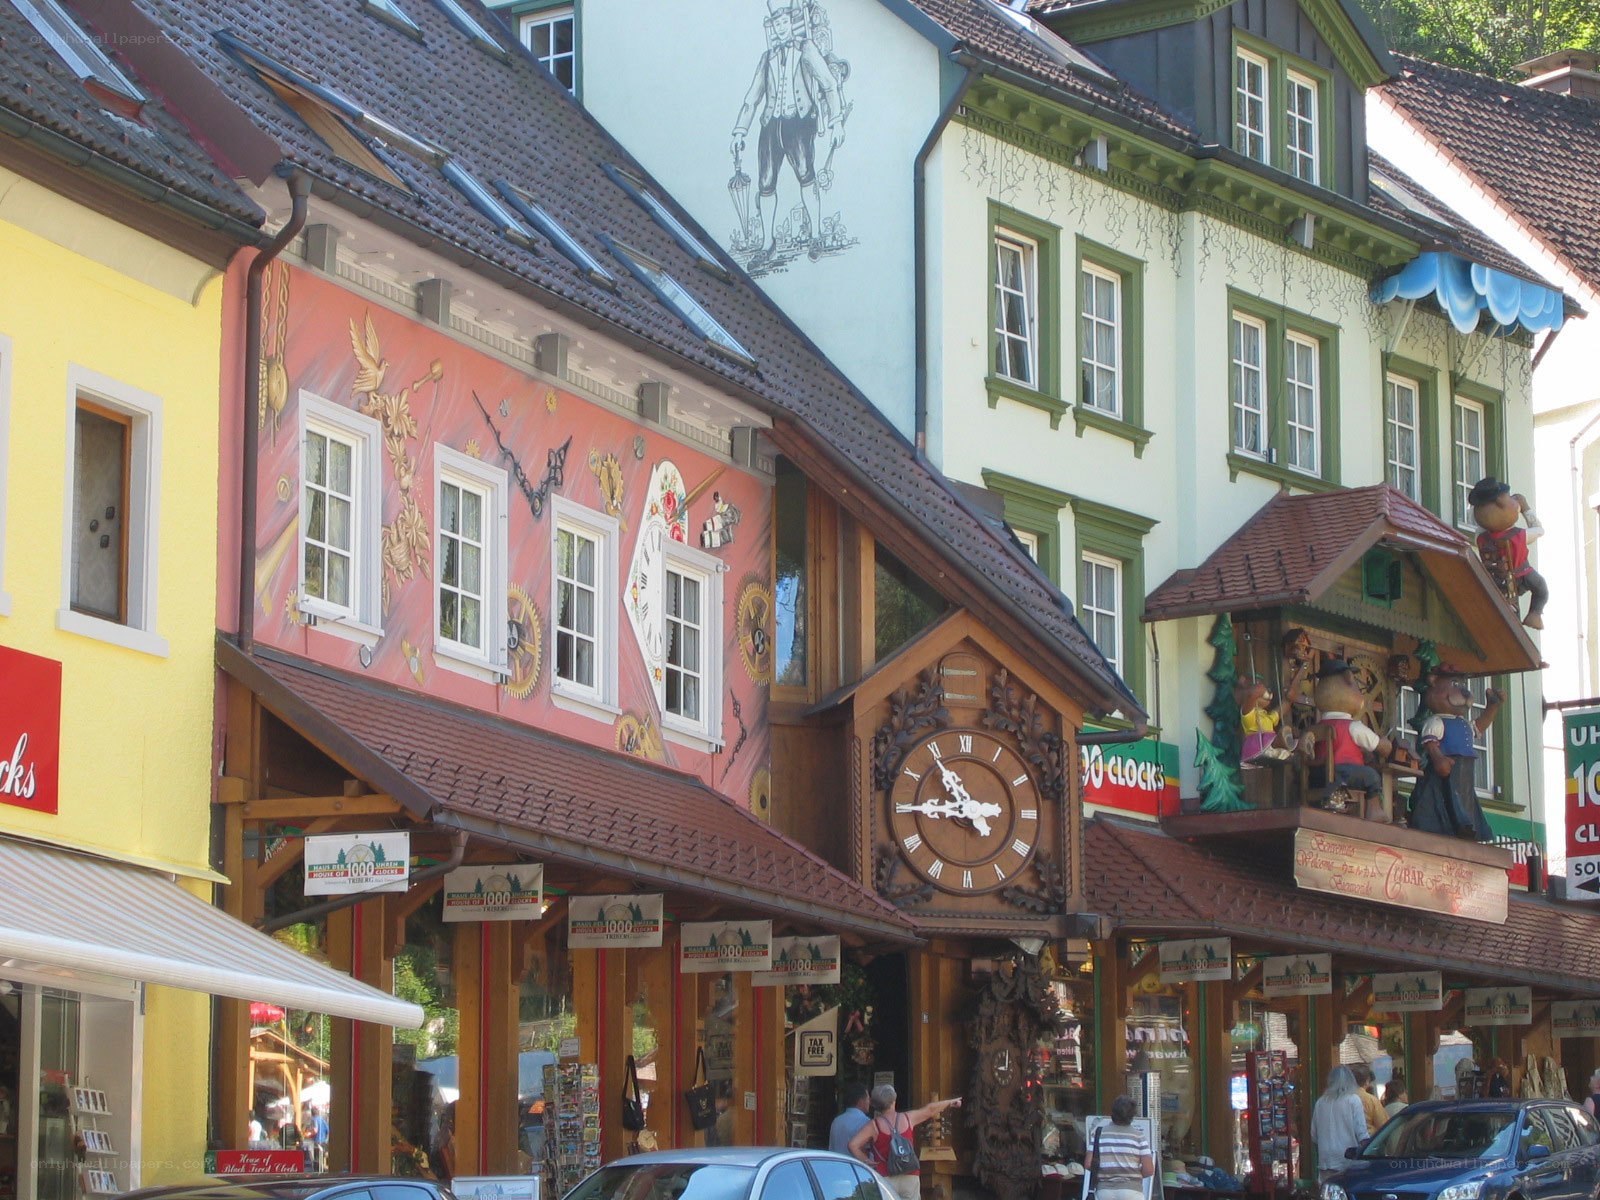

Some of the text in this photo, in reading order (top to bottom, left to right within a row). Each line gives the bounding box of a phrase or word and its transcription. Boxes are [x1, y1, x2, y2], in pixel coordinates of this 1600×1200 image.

[959, 735, 972, 753] XII
[904, 767, 920, 781] X
[1108, 755, 1164, 791] CLOCKS
[1013, 774, 1028, 787] II
[1021, 809, 1037, 820] III
[1574, 823, 1600, 843] CL
[904, 834, 922, 853] VIII
[348, 861, 375, 878] 1000
[928, 859, 943, 879] VII
[994, 864, 1005, 880] V
[963, 870, 972, 888] VI
[484, 891, 511, 906] 1000
[606, 920, 632, 933] 1000
[718, 945, 743, 958] 1000
[788, 959, 812, 971] 1000
[809, 1038, 823, 1047] TAX
[807, 1046, 825, 1055] FREE
[240, 1153, 272, 1166] House of
[222, 1163, 246, 1173] Black
[249, 1163, 271, 1173] Forest
[274, 1162, 298, 1173] Clocks
